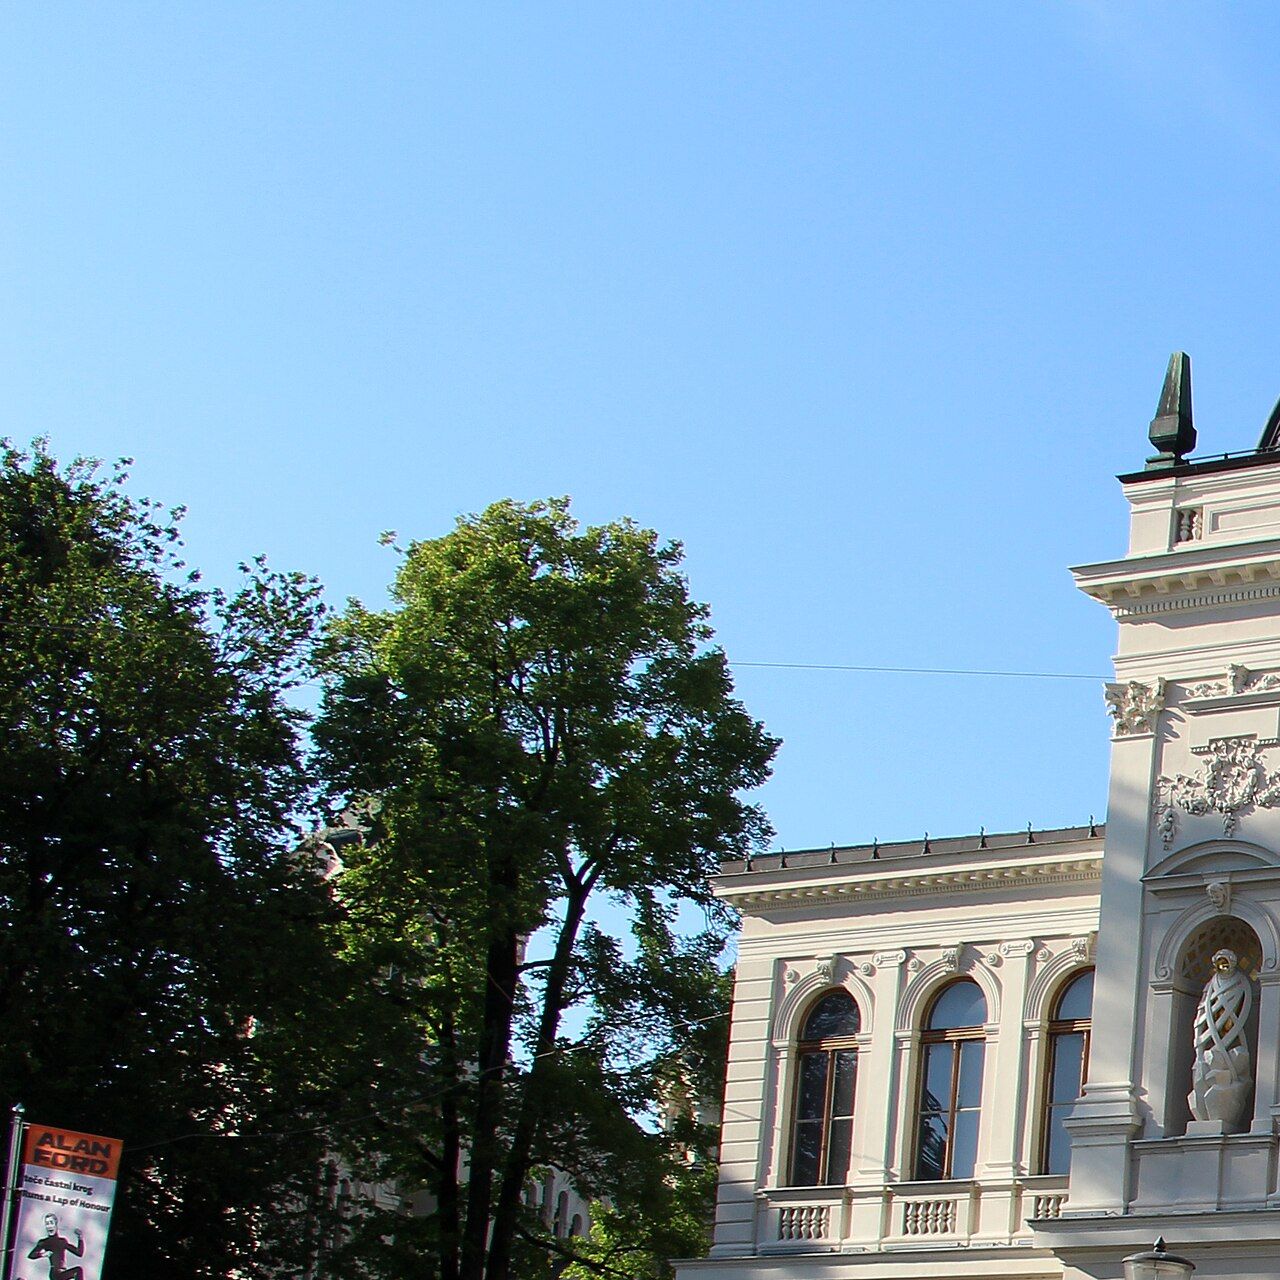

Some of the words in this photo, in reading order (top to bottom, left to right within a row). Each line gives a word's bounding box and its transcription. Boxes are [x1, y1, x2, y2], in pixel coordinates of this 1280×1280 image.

[37, 1132, 111, 1158] ALAN
[34, 1147, 109, 1175] FORD
[44, 1177, 72, 1190] častni
[73, 1182, 94, 1195] krog
[53, 1195, 68, 1206] Lap
[70, 1198, 79, 1206] of
[80, 1200, 111, 1212] Honour
